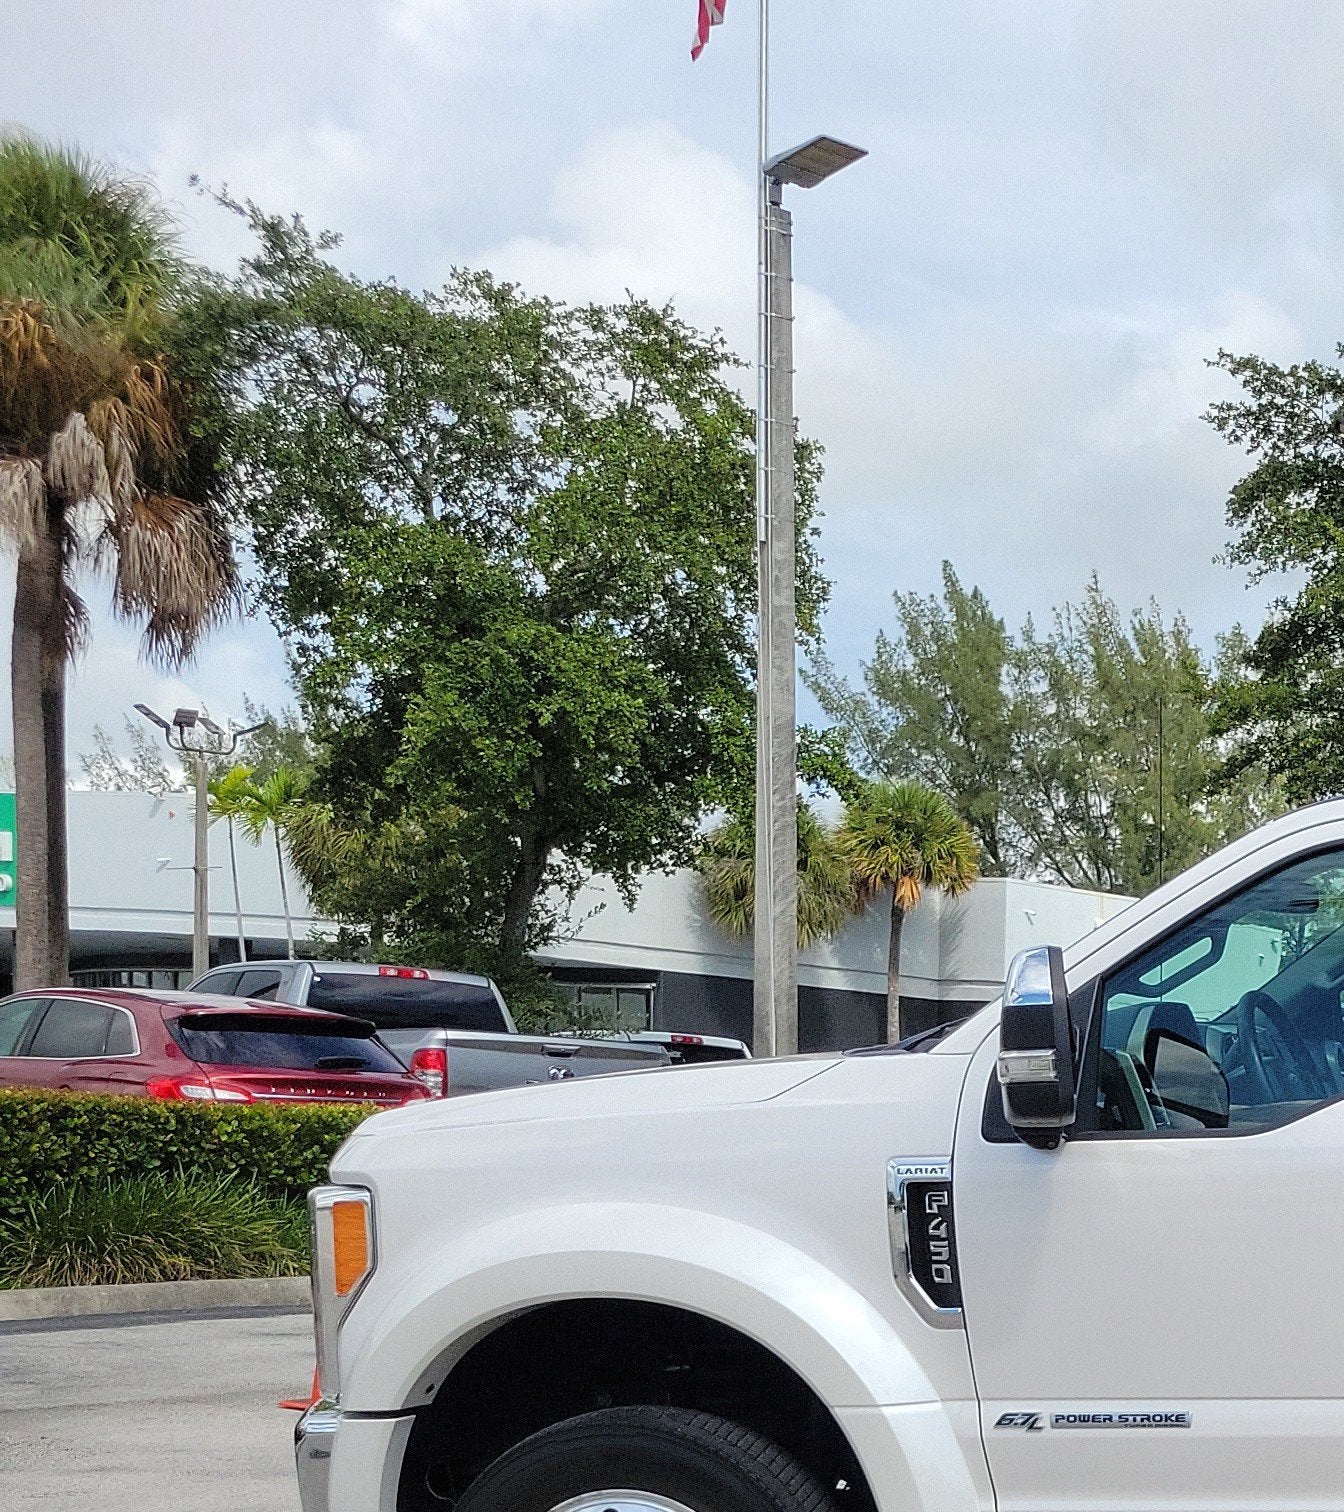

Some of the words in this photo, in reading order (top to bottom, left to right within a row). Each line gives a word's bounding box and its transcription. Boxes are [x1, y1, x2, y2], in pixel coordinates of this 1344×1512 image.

[896, 1167, 947, 1175] LARIAT
[925, 1190, 953, 1284] F450
[993, 1412, 1044, 1432] 6.7L
[1054, 1413, 1114, 1424] POWER
[1118, 1413, 1187, 1424] STROKE
